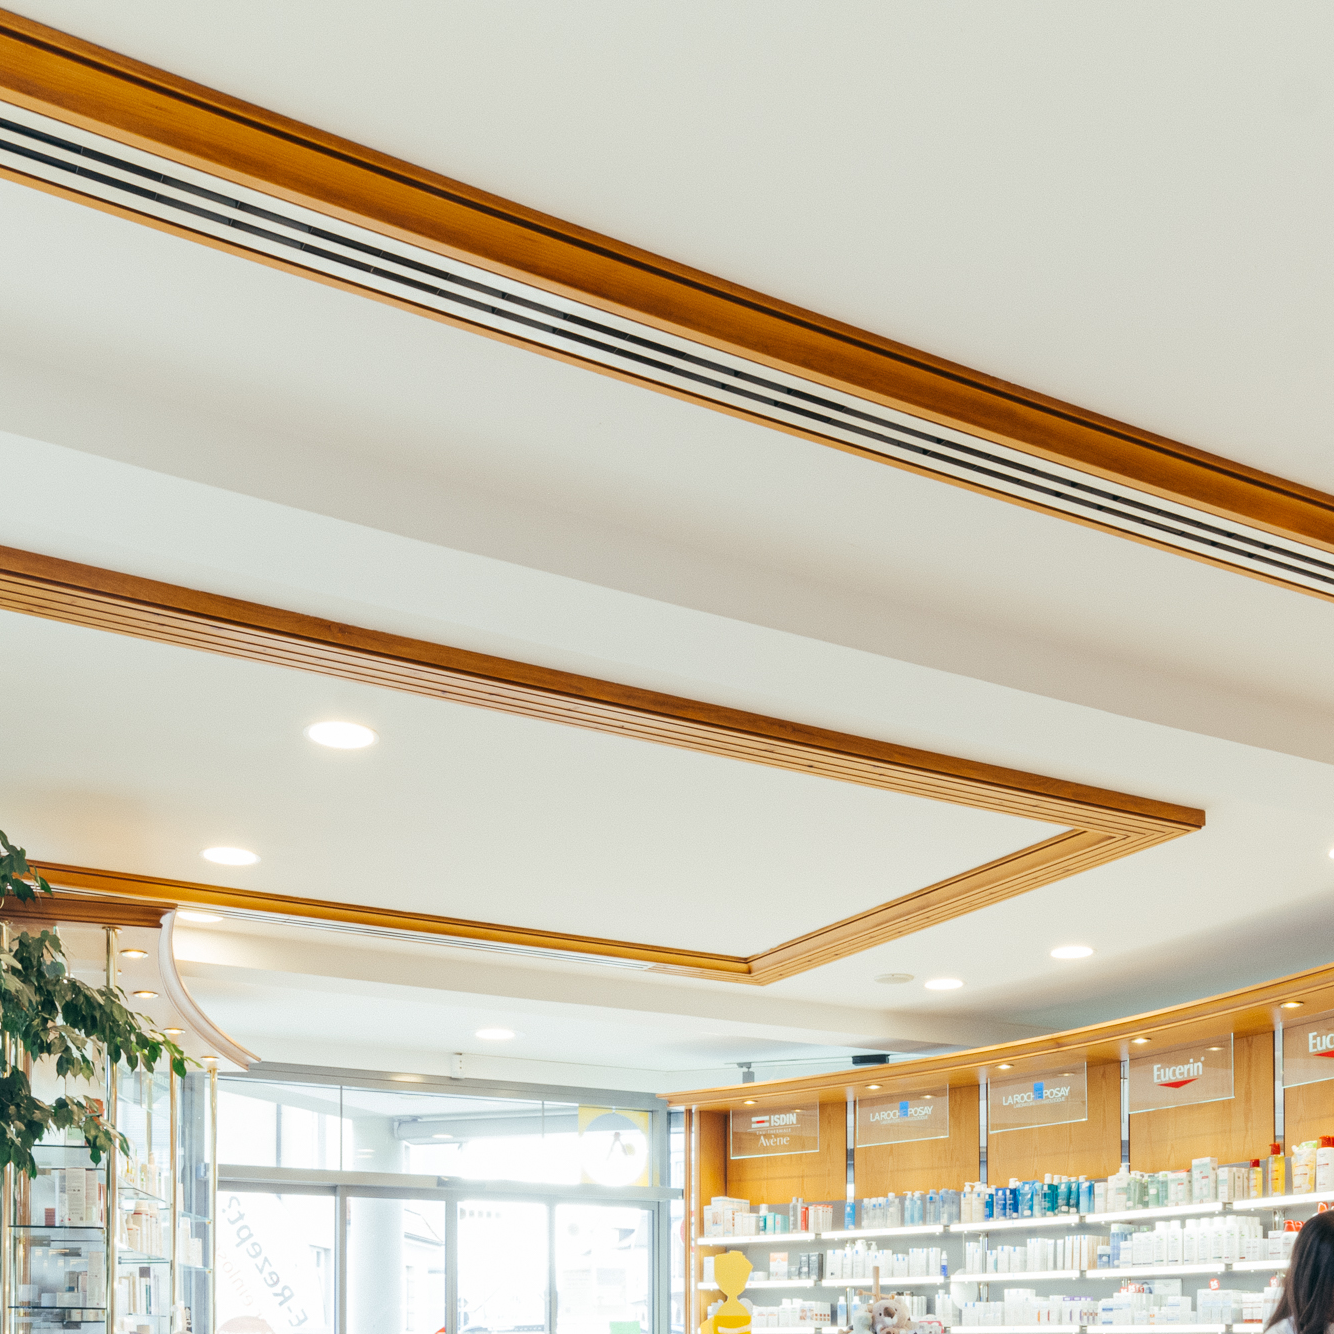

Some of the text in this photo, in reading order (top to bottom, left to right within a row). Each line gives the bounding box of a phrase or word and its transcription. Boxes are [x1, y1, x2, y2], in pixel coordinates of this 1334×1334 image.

[1153, 1058, 1204, 1083] Eucerin
[1043, 1085, 1071, 1099] POSAY
[909, 1106, 933, 1118] POSAY
[771, 1113, 797, 1127] ISDIN
[758, 1135, 790, 1147] Avène
